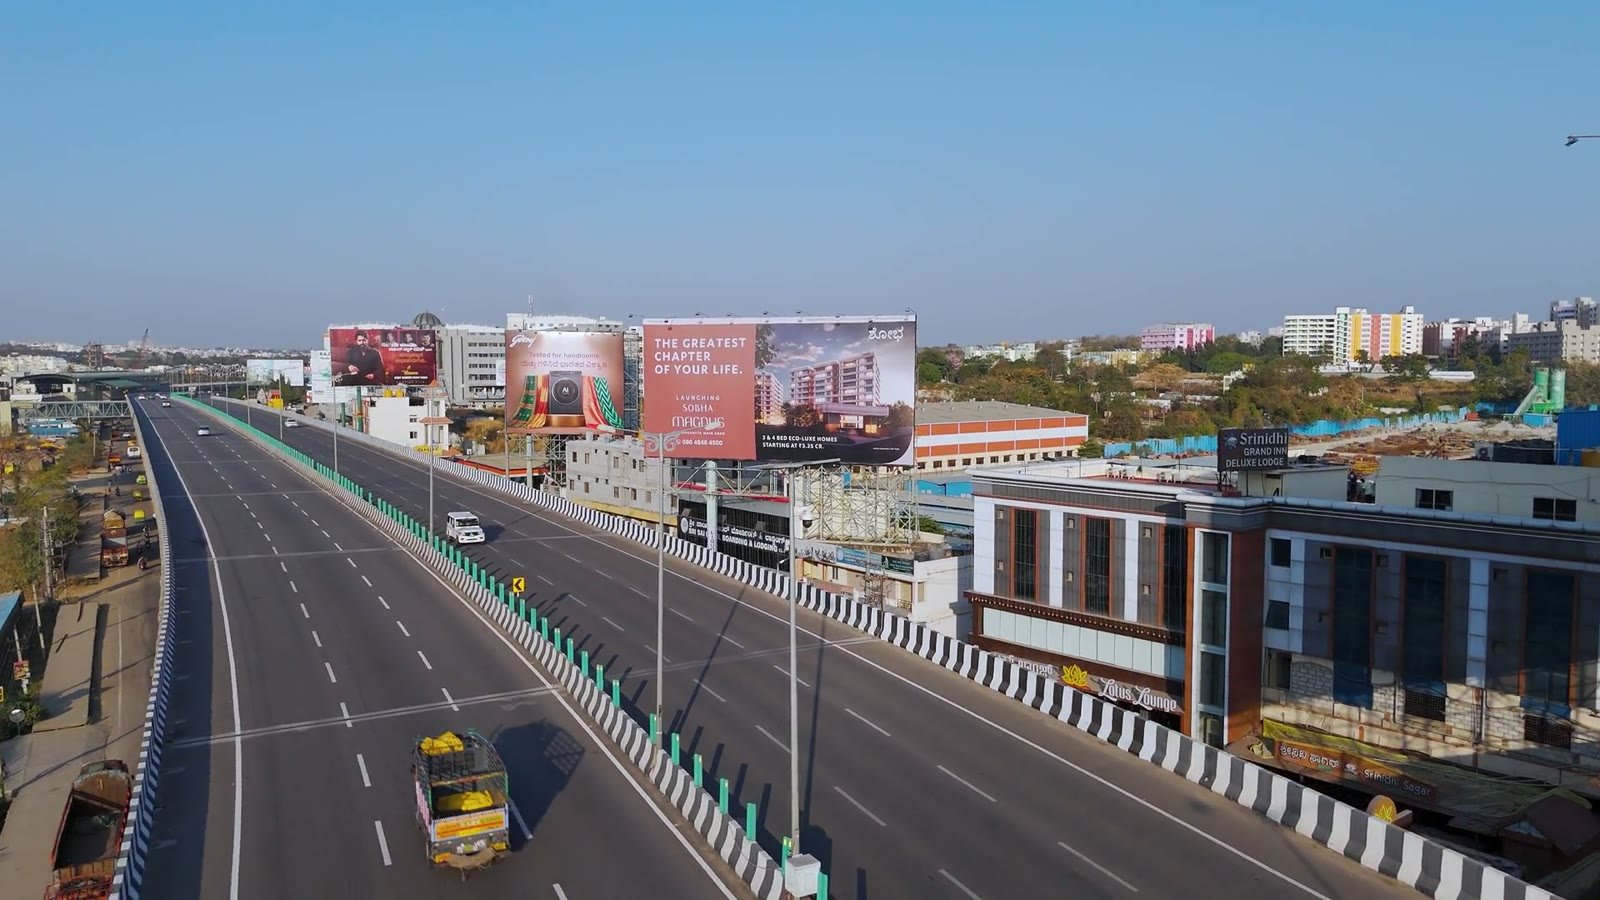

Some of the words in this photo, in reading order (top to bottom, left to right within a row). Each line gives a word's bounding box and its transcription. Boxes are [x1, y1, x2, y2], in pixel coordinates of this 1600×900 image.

[655, 338, 678, 348] THE
[682, 338, 746, 348] GREATEST
[654, 351, 711, 361] CHAPTER
[654, 364, 670, 374] OF
[674, 364, 708, 374] YOUR
[713, 364, 743, 374] LIFE.
[682, 404, 714, 412] SOBHA
[1240, 432, 1287, 445] Srinidhi
[1243, 447, 1272, 456] GRAND
[1273, 447, 1288, 455] INN
[1226, 459, 1257, 468] DELUXE
[1257, 457, 1284, 467] LODGE
[722, 534, 747, 546] BOARDING
[754, 540, 777, 552] LODGING
[1098, 677, 1132, 702] Lotus
[1132, 685, 1177, 712] Lounge
[1363, 768, 1399, 786] Srinidhi
[1403, 781, 1431, 797] Sagar
